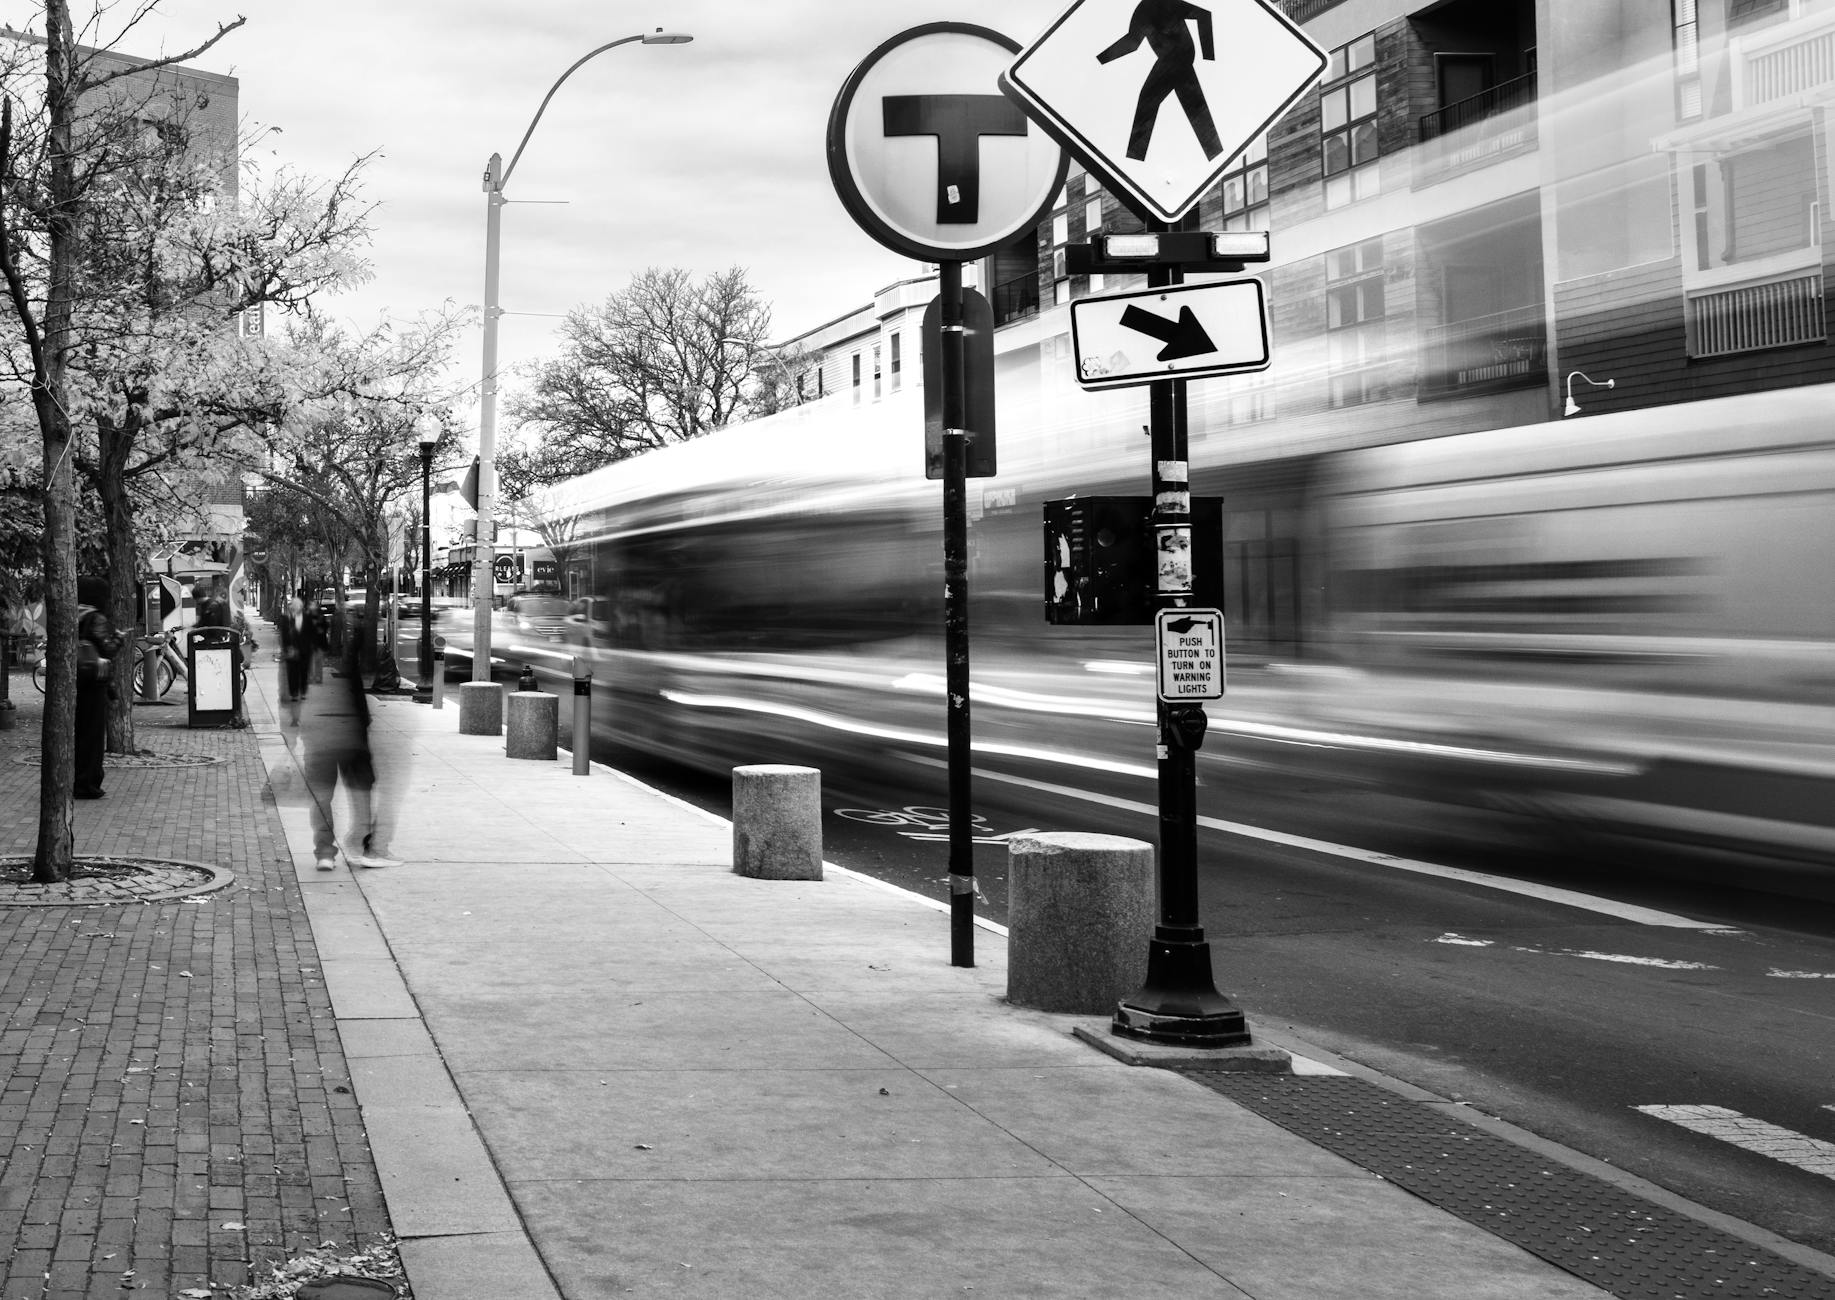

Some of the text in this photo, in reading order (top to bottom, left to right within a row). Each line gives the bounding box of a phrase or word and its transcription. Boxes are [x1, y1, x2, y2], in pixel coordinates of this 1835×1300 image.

[882, 94, 1028, 224] T
[1180, 638, 1202, 646] PUSH
[1168, 649, 1215, 658] BUTTON TO
[1172, 661, 1211, 670] TURN ON
[1174, 672, 1211, 682] WARNING
[1178, 684, 1207, 693] LIGHTS
